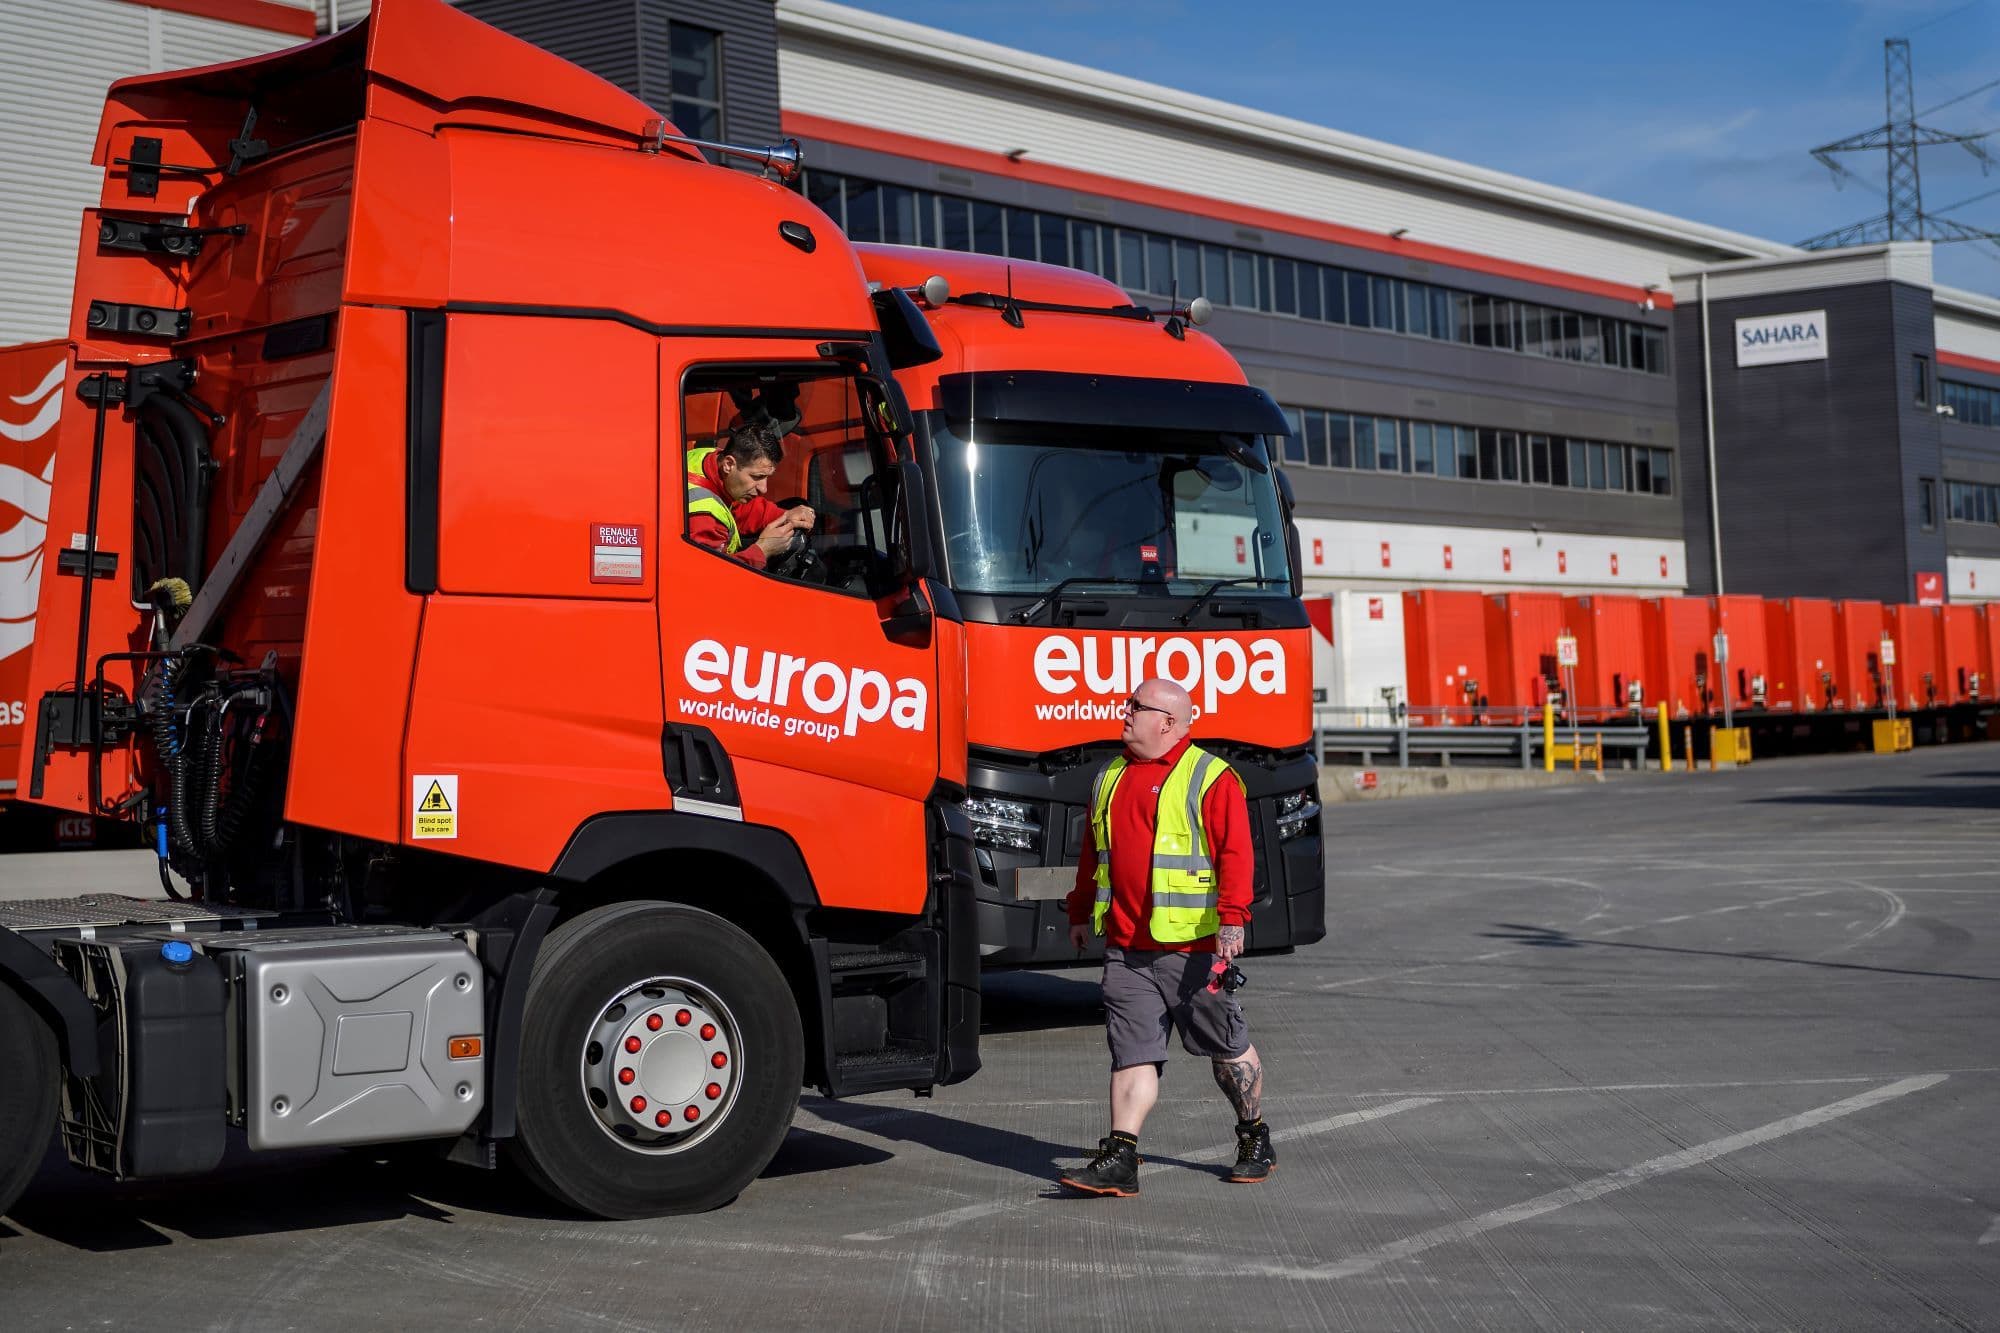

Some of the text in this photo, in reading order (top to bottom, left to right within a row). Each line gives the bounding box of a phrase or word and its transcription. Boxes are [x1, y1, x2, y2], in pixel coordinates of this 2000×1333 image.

[1742, 322, 1819, 347] SAHARA
[599, 527, 638, 537] RENAULT
[600, 535, 638, 545] TRUCKS
[1033, 635, 1287, 714] europa
[683, 639, 928, 737] europa
[678, 698, 840, 743] worldwide group
[1034, 699, 1128, 721] worldwid
[436, 817, 452, 825] spot
